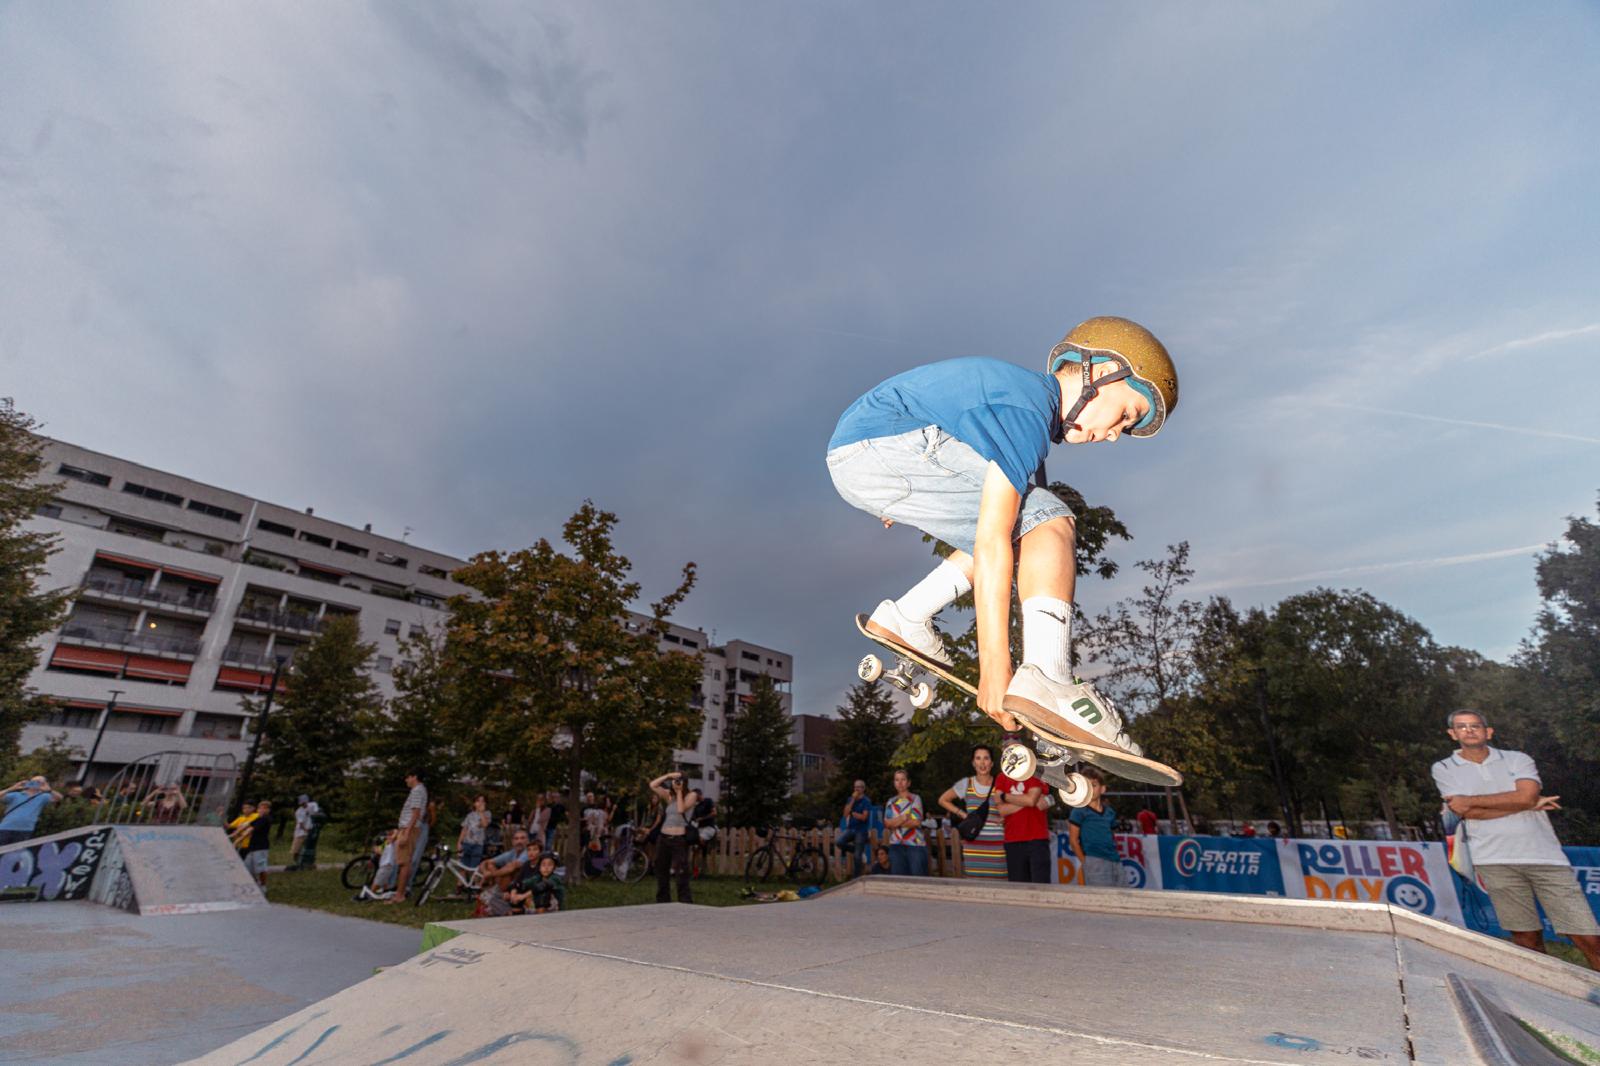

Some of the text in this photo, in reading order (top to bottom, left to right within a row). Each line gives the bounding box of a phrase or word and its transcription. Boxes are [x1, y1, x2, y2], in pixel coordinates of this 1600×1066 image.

[1200, 849, 1262, 864] SKATE
[1297, 843, 1431, 886] ROLLER
[1196, 861, 1261, 876] ITALIA
[1304, 875, 1385, 902] DAY
